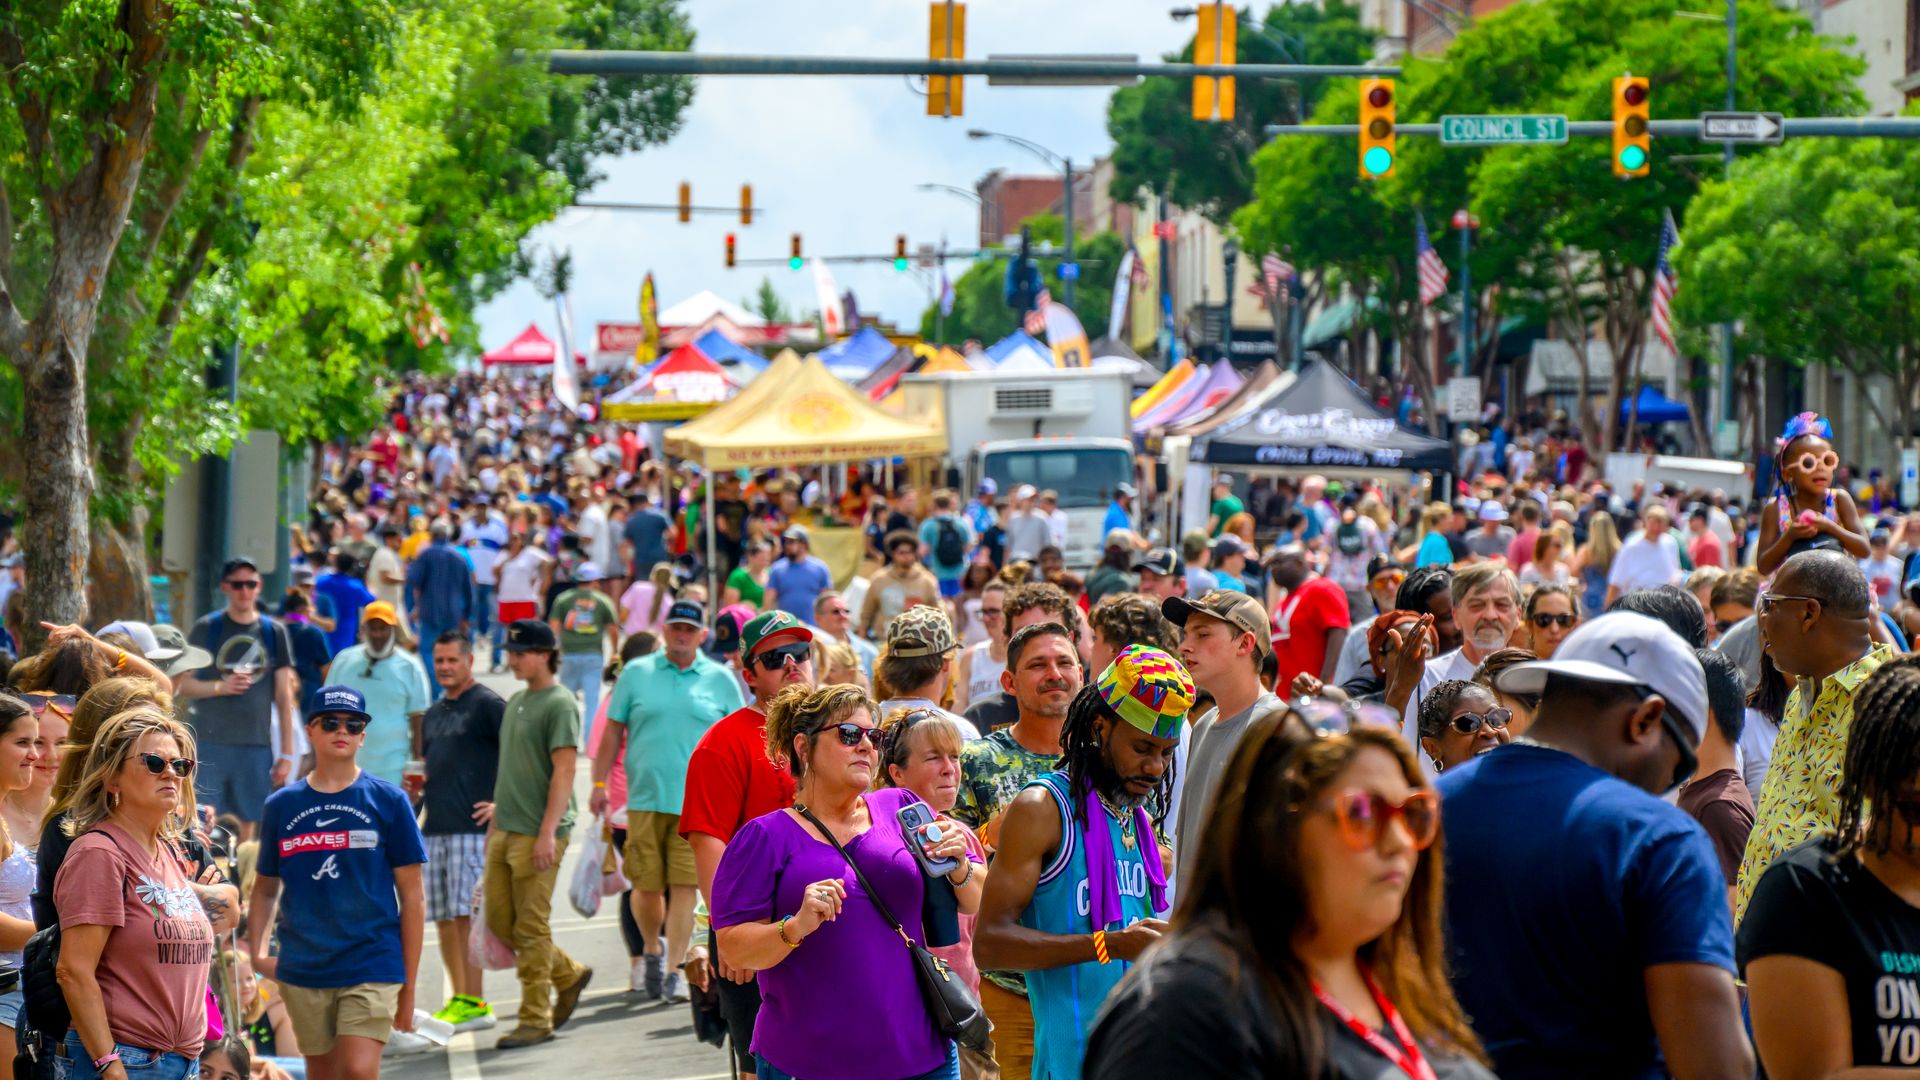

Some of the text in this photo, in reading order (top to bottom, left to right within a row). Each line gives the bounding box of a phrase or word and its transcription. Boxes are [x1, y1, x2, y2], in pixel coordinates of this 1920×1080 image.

[1449, 119, 1560, 139] COUNCIL ST
[324, 691, 359, 703] RIPKEN
[324, 698, 358, 709] BASEBALL
[286, 803, 372, 831] DIVISION CHAMPIONS
[282, 833, 346, 852] BRAVES
[153, 919, 205, 940] CONSIDER
